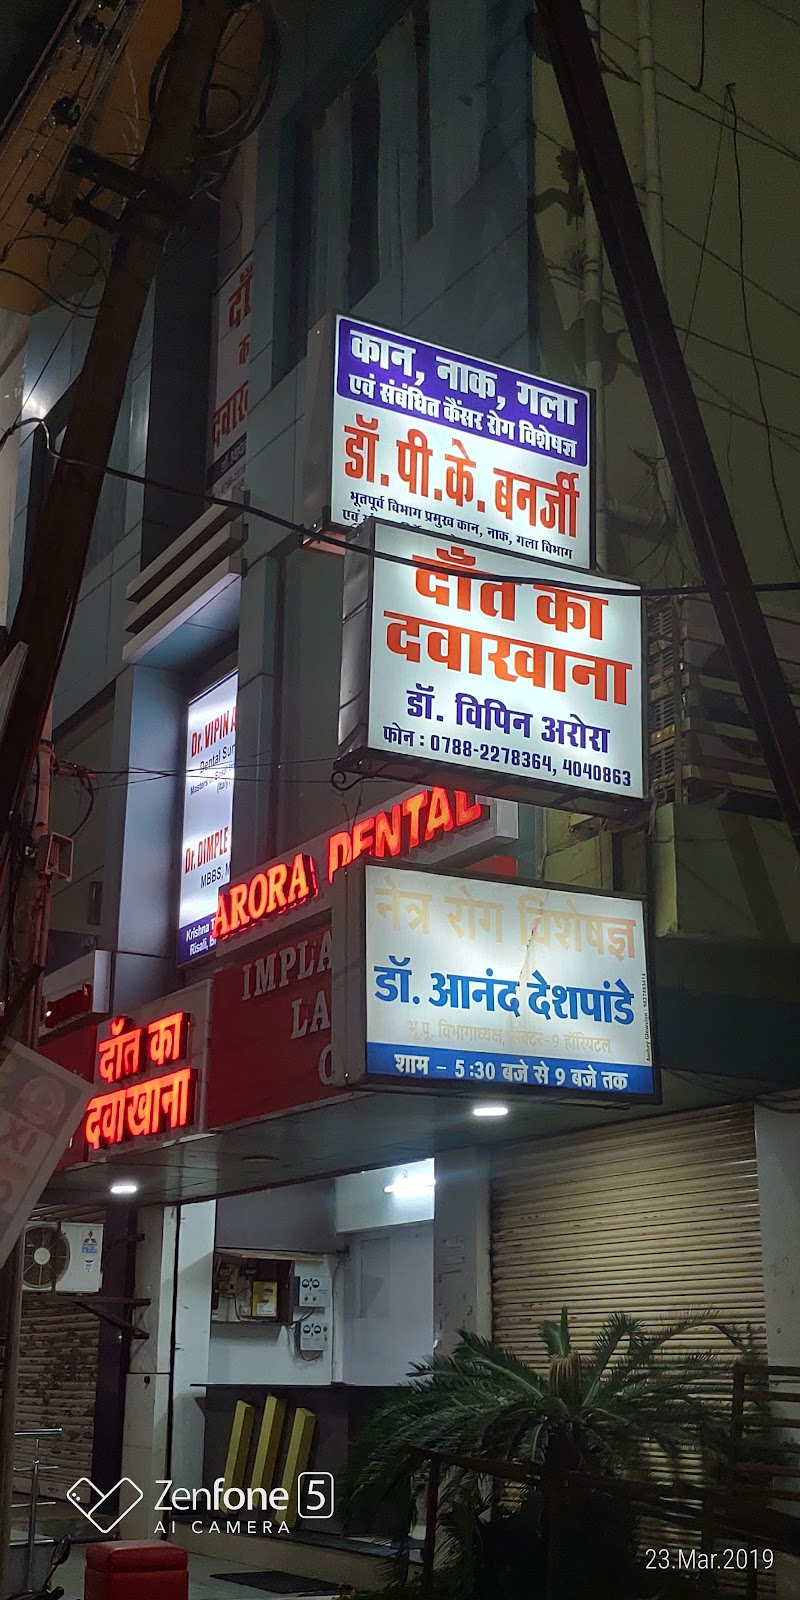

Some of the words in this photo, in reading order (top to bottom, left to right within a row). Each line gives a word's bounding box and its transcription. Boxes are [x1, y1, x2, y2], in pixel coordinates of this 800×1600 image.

[350, 329, 425, 386] कान,
[436, 355, 506, 411] नाक,
[516, 381, 578, 426] गला
[348, 373, 377, 399] एवं
[379, 379, 441, 418] संबंधित
[443, 396, 484, 431] कैंसर
[486, 409, 515, 440] रोग
[519, 420, 577, 458] विशेषज्ञ
[344, 413, 389, 487] डॉ.
[493, 467, 580, 538] बनर्जी
[350, 491, 385, 512] भूतपूर्व
[388, 498, 422, 519] विभाग
[425, 511, 455, 528] प्रमुख
[456, 519, 483, 537] कान,
[487, 527, 513, 546] नाक,
[516, 535, 539, 550] गला
[541, 539, 573, 560] विभाग
[533, 583, 609, 640] का
[383, 610, 632, 706] दवाखाना
[191, 732, 203, 757] Dr.
[204, 710, 230, 749] VIPIN
[406, 683, 444, 722] डॉ.
[455, 692, 534, 739] विपिन
[541, 713, 610, 753] अरोरा
[200, 749, 221, 773] Dental
[383, 722, 415, 747] फोन
[430, 734, 557, 776] 0788-2278364,
[562, 758, 631, 787] 4040863
[185, 847, 196, 874] Dr.
[197, 827, 228, 867] DIMPLE
[212, 853, 310, 938] ARORA
[328, 786, 482, 884] DENTAL
[186, 923, 210, 942] Krishna
[374, 874, 432, 935] नेत्र
[444, 885, 504, 943] रोग
[517, 892, 636, 961] विशेषज्ञ
[242, 930, 332, 1001] IMPLA
[374, 955, 420, 1005] डॉ.
[429, 968, 520, 1018] आनंद
[526, 969, 634, 1025] देशपांडे
[147, 1011, 183, 1066] का
[394, 1054, 430, 1075] शाम
[501, 1059, 528, 1083] बजे
[533, 1061, 549, 1084] से
[554, 1067, 566, 1085] 9
[570, 1065, 597, 1088] बजे
[601, 1071, 629, 1090] तक
[85, 1068, 191, 1150] दवाखाना
